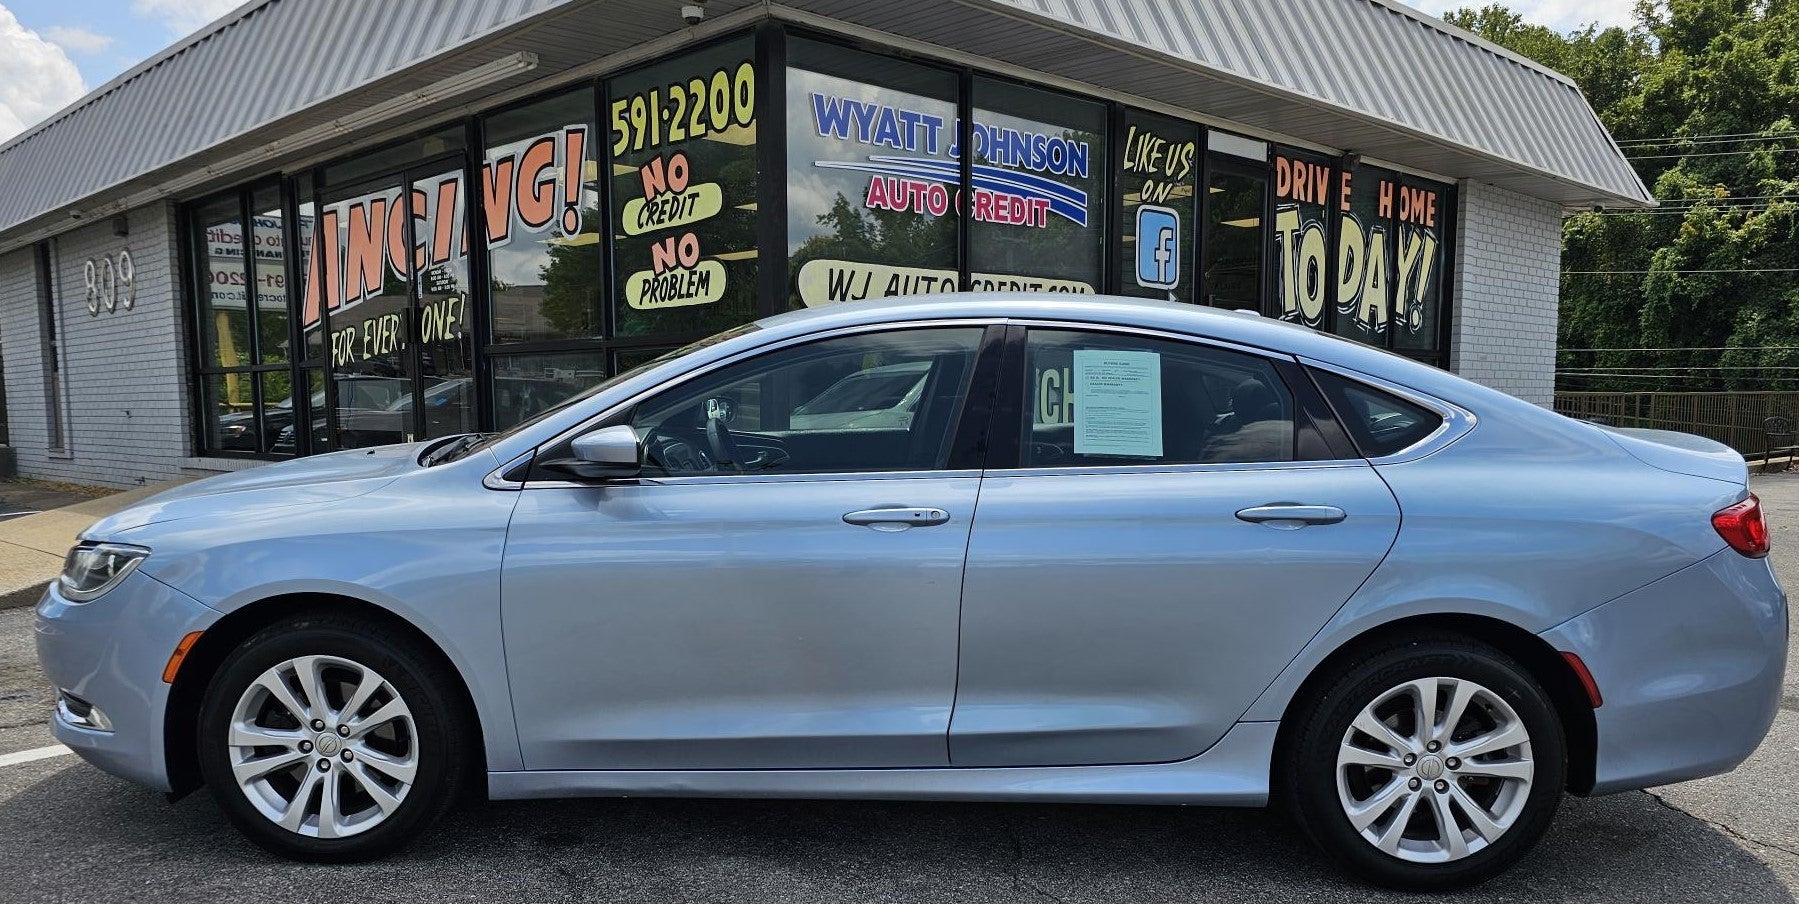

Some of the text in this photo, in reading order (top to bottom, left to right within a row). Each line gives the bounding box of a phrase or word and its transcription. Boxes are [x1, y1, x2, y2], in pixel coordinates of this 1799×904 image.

[811, 92, 943, 155] WYATT
[1123, 125, 1195, 181] LIKE US
[641, 152, 689, 201] NO
[865, 174, 948, 216] AUTO
[1140, 179, 1173, 204] ON
[1276, 155, 1436, 227] DRIVE HOME
[637, 191, 700, 229] CREDIT
[651, 232, 700, 275] NO
[1276, 204, 1438, 335] TODAY!
[85, 250, 135, 316] 809
[639, 269, 711, 305] PROBLEM
[828, 267, 872, 302] WJ
[331, 326, 355, 369] FOR
